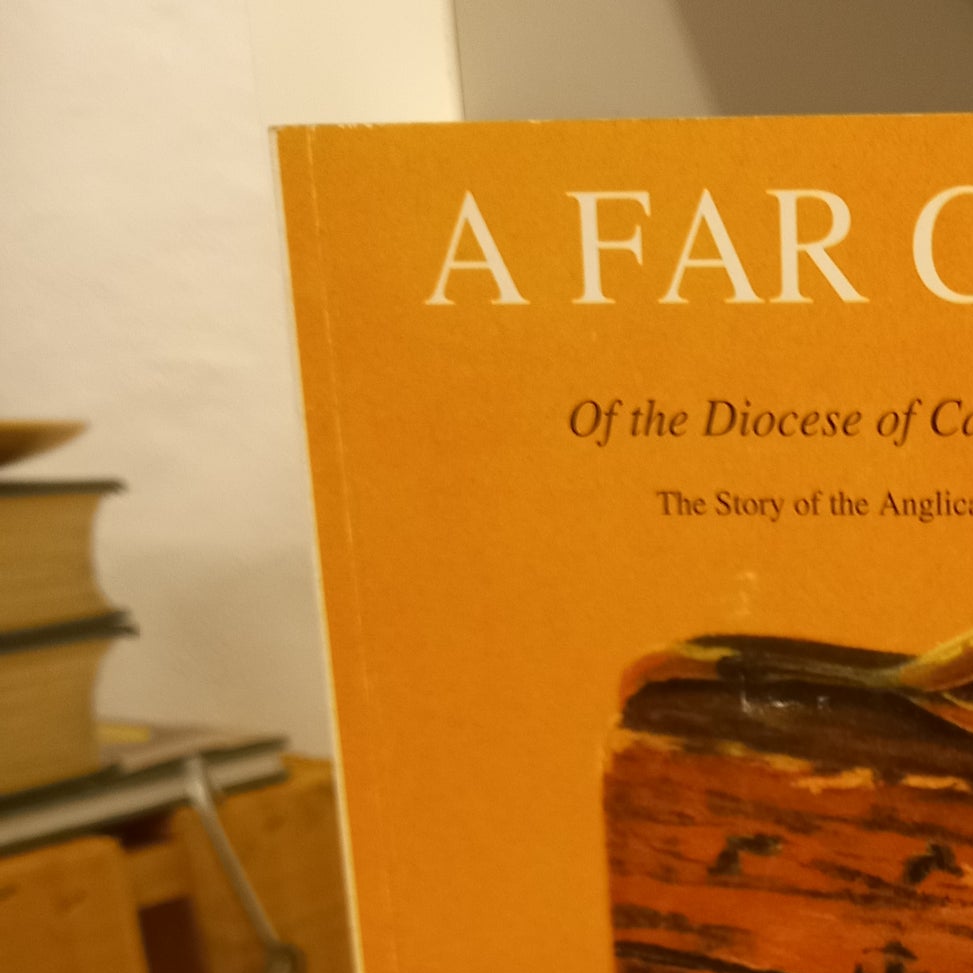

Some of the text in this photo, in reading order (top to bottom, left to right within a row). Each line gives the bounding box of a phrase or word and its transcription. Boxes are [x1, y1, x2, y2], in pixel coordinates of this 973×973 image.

[424, 190, 530, 305] A
[566, 188, 870, 305] FAR
[568, 400, 622, 448] Of
[629, 402, 689, 437] the
[701, 400, 862, 438] Diocese
[876, 400, 922, 448] of
[656, 491, 707, 516] The
[715, 492, 784, 522] Story
[793, 490, 823, 516] of
[829, 491, 869, 516] the
